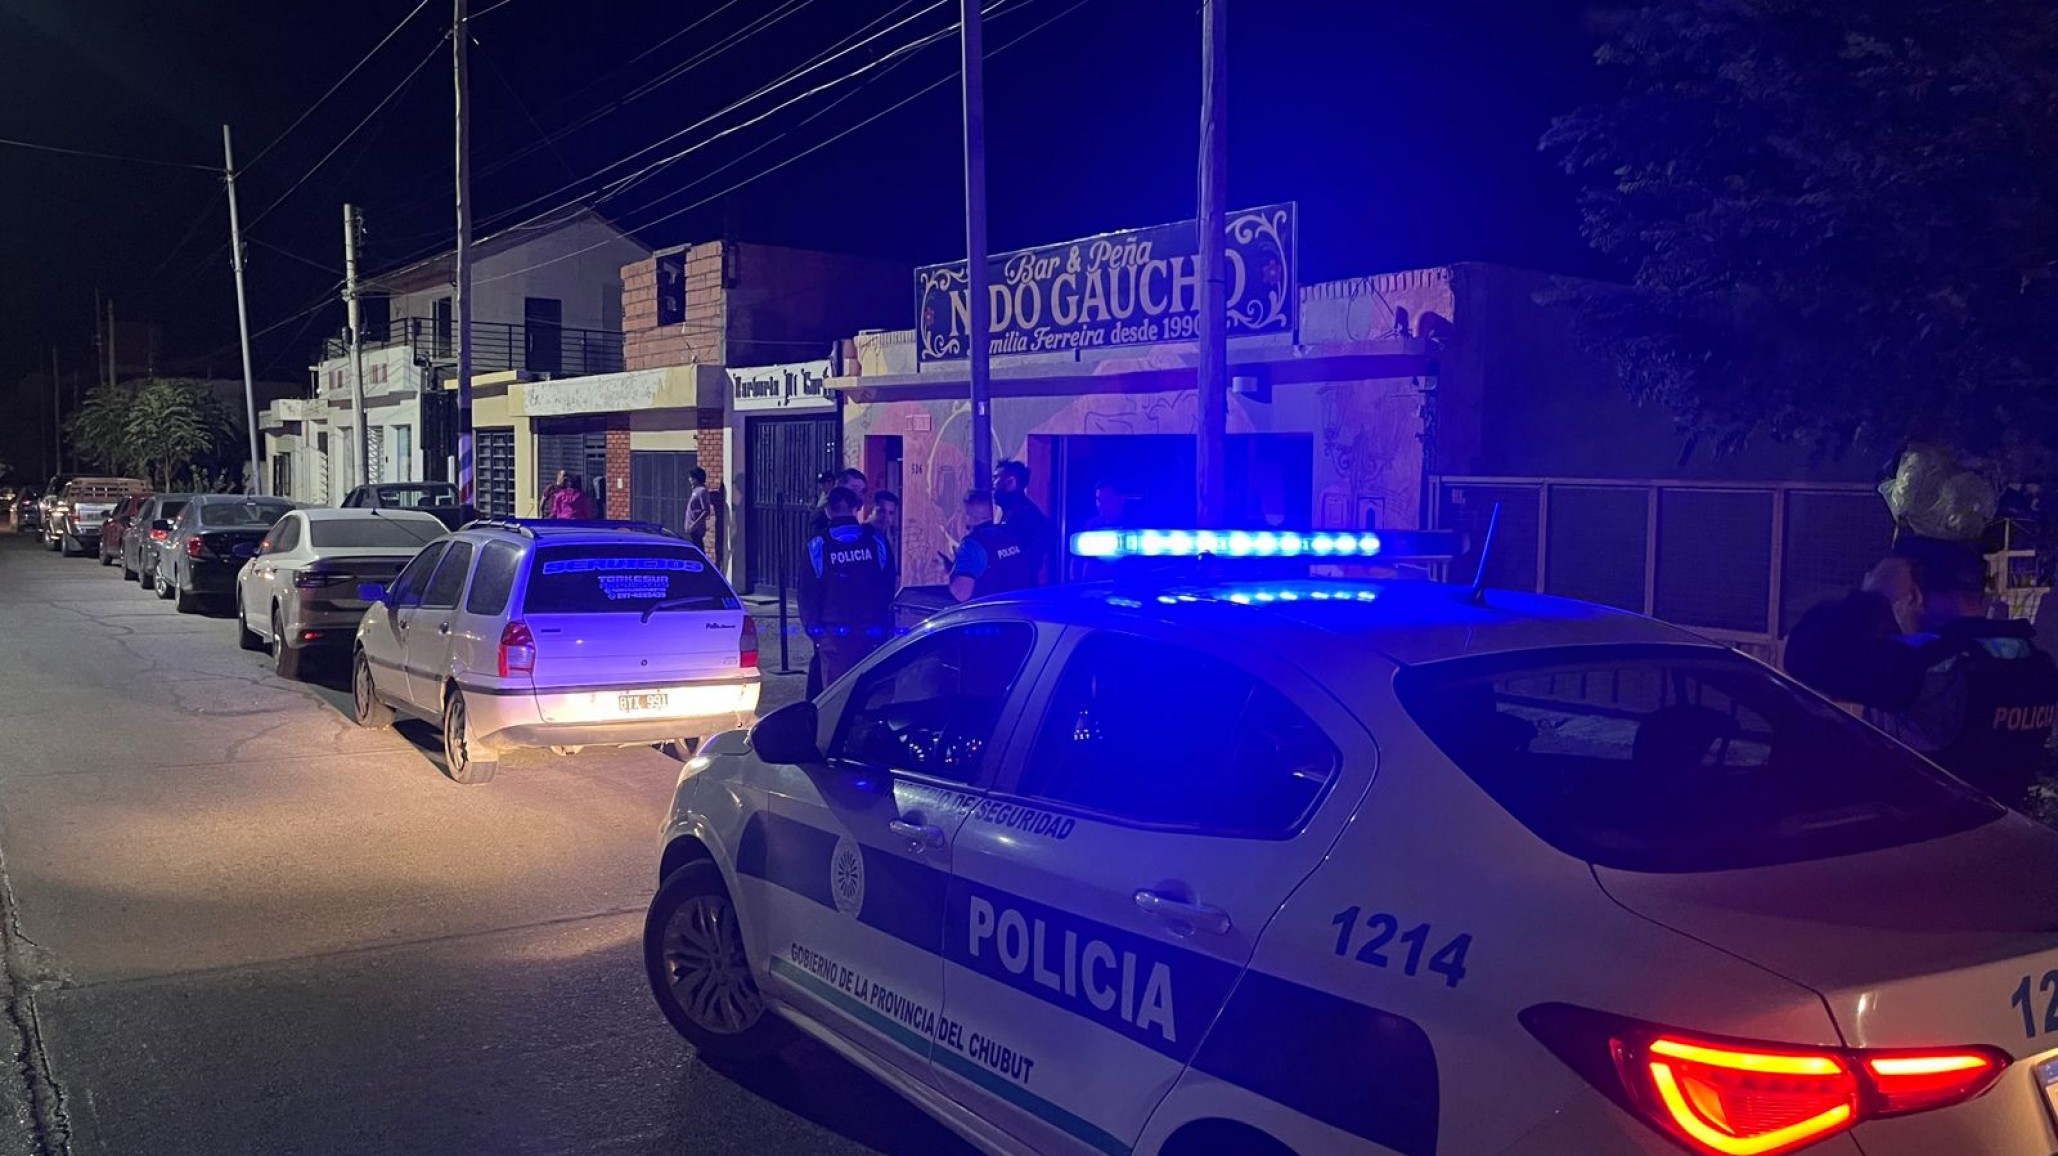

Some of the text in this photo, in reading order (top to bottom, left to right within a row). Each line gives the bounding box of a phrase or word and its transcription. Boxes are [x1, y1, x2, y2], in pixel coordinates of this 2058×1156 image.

[1004, 236, 1153, 285] Bar & Peña
[949, 281, 1041, 337] NDO
[1030, 324, 1105, 351] Ferreira
[1110, 319, 1158, 345] desde
[830, 548, 873, 565] POLICIA
[997, 545, 1021, 560] POLICIA
[976, 799, 1077, 840] SEGURIDAD
[969, 895, 1177, 1043] POLICIA
[1332, 905, 1473, 989] 1214
[791, 942, 1035, 1084] GOBIERNO DE LA PROVINCIA DEL CHUBUT
